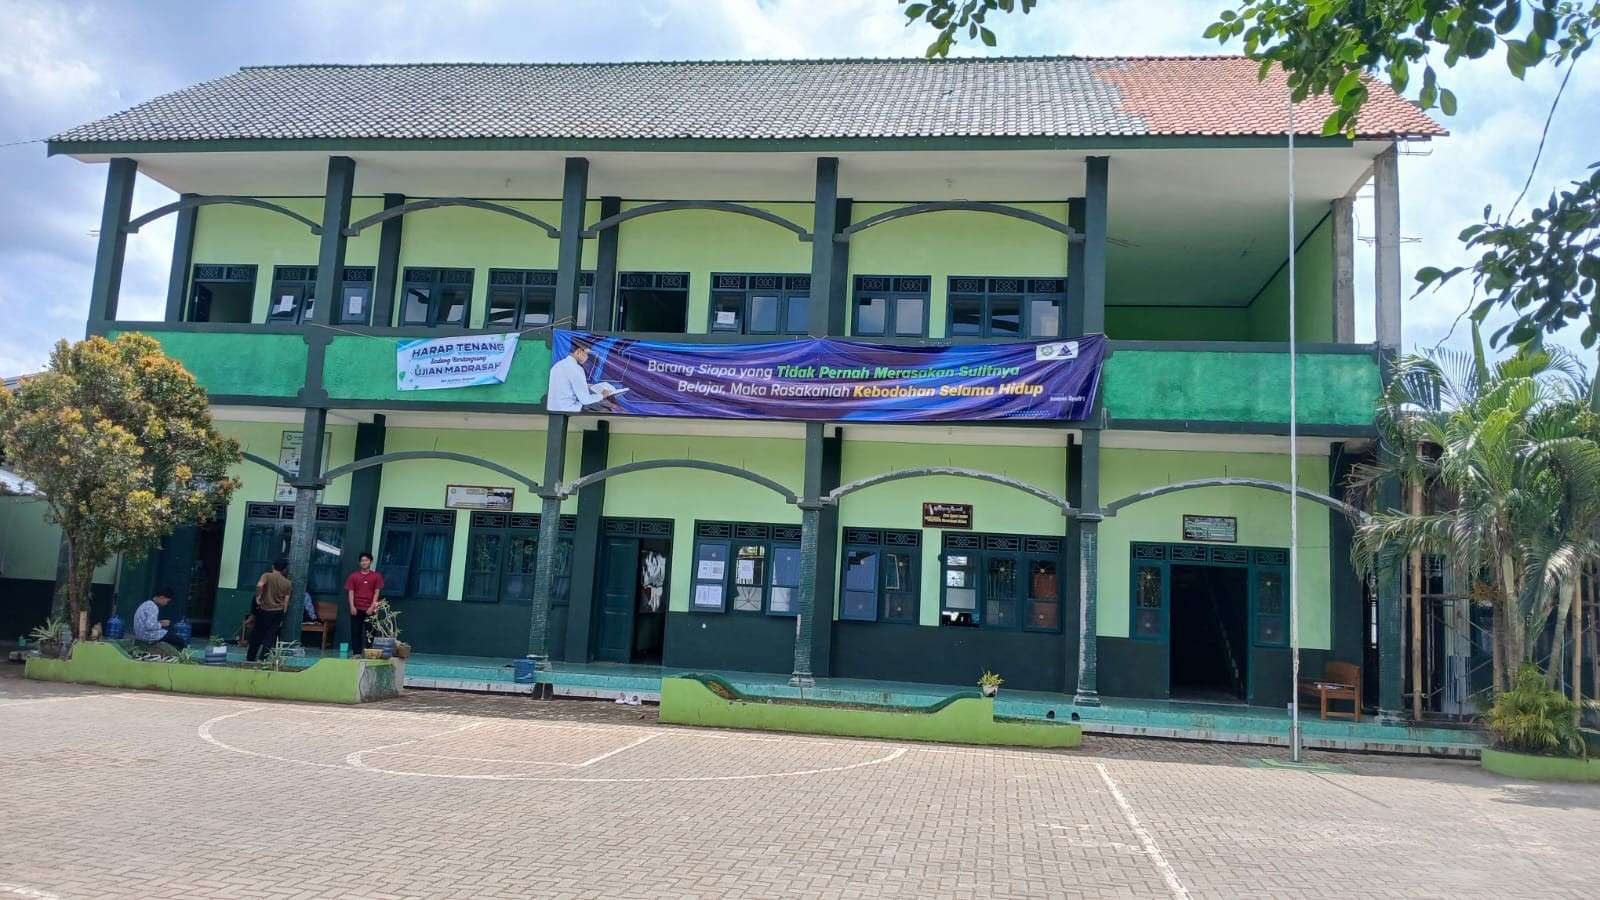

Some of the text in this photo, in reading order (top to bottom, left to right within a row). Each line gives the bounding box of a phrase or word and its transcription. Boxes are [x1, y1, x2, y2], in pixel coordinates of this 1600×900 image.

[412, 343, 505, 358] HARAP TENANG
[414, 367, 443, 376] UJIAN
[647, 360, 1020, 380] Barang Siapa yang Tidak Pernah Merasakan Sulitnya
[730, 383, 767, 396] Maka
[770, 383, 850, 398] Rasakanlah
[853, 384, 936, 398] Kebodohan
[939, 384, 995, 397] Selama
[998, 382, 1044, 397] Hidup
